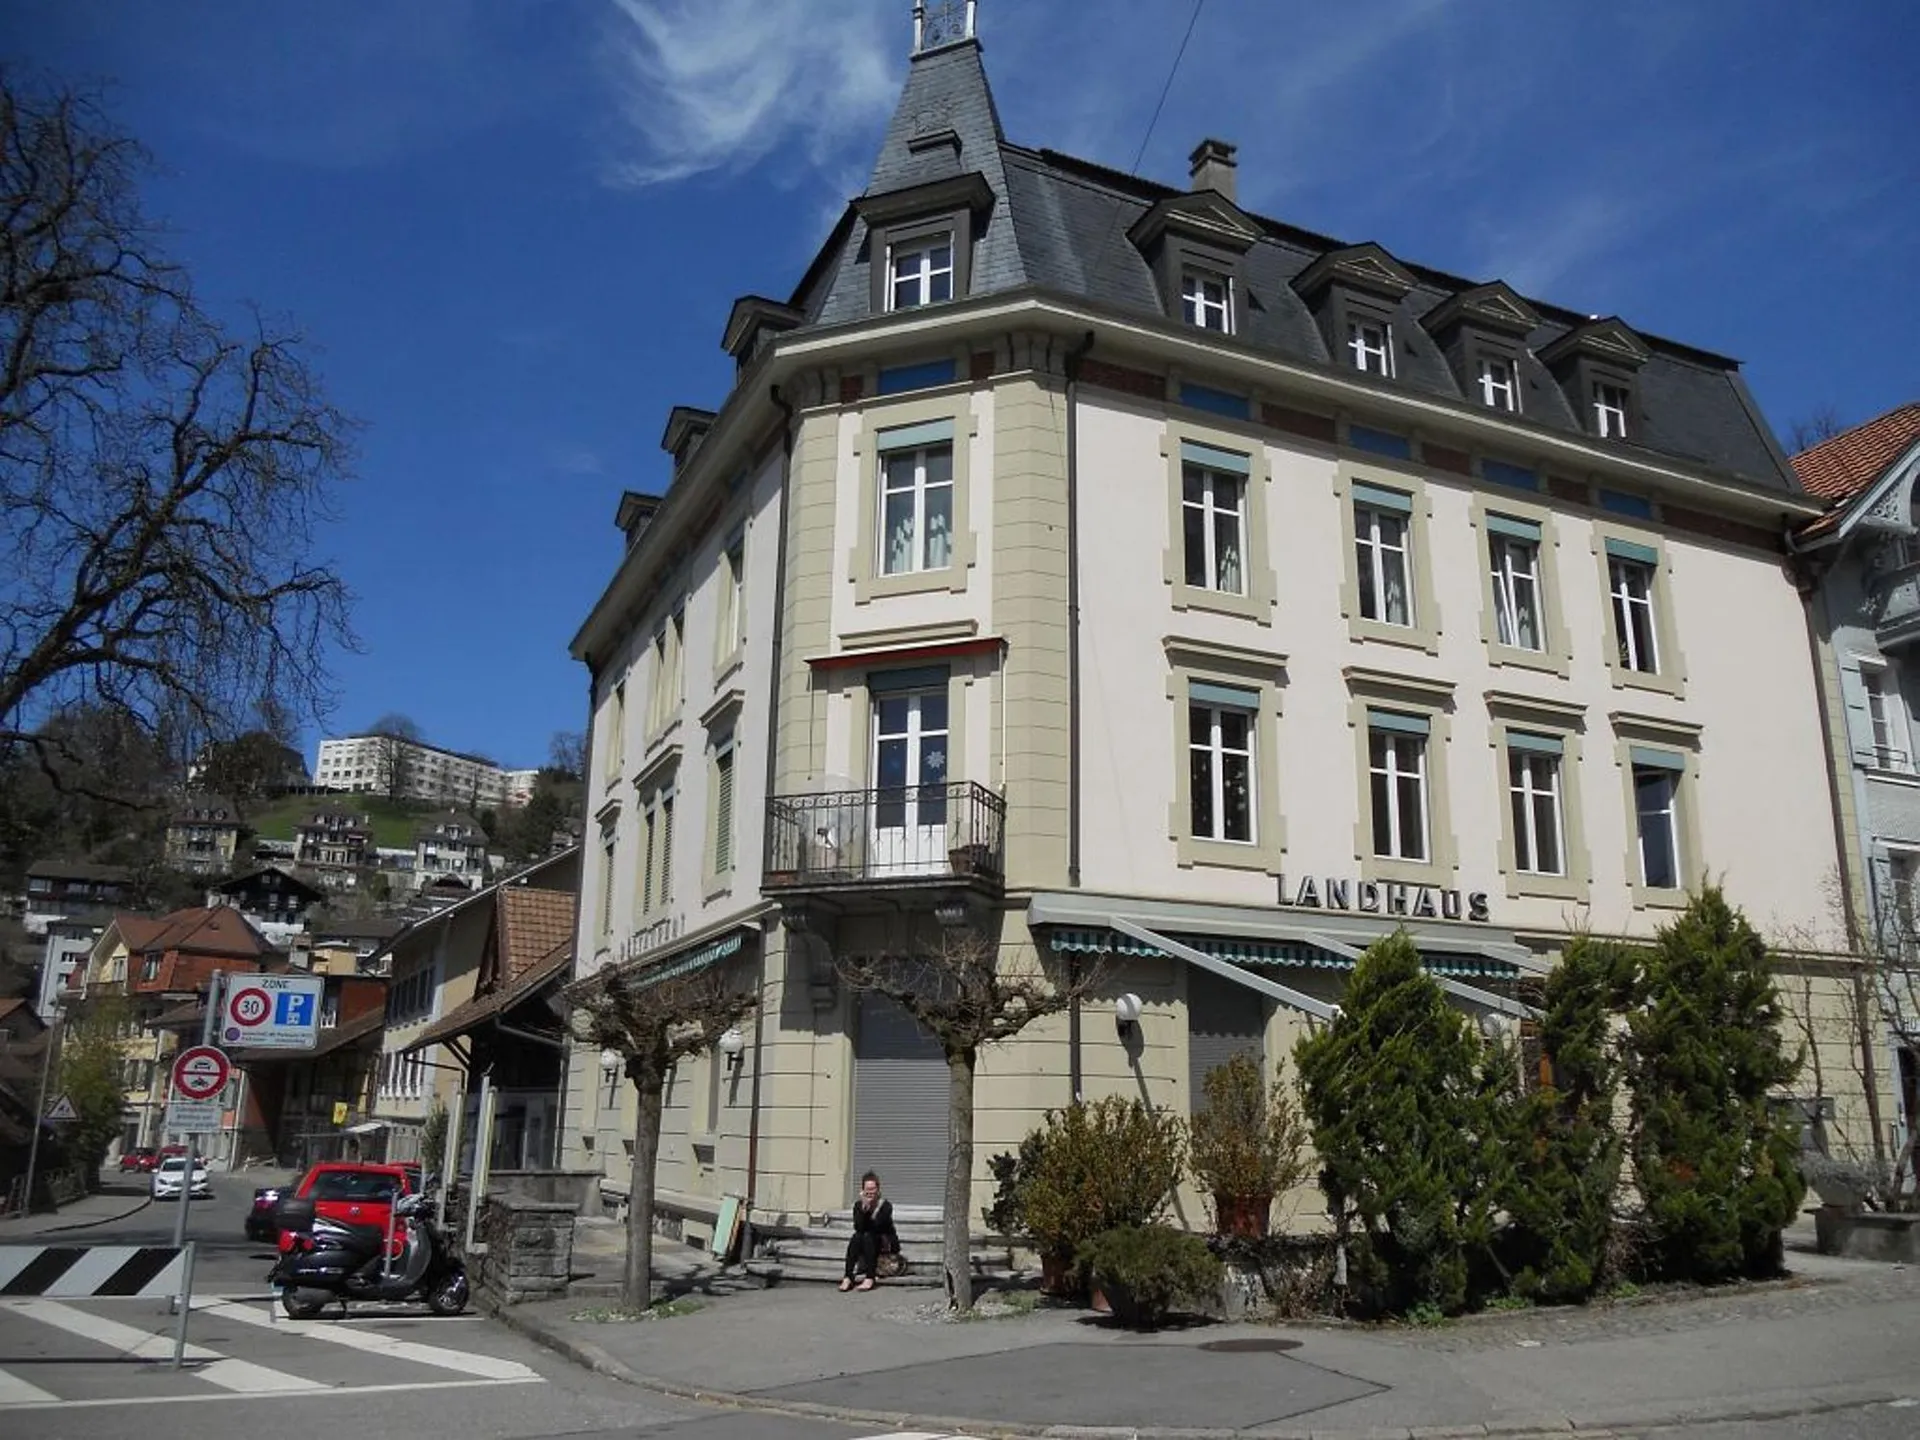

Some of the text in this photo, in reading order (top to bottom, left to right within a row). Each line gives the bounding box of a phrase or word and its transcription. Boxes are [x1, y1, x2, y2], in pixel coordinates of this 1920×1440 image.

[1277, 873, 1490, 923] LANDHAUS
[261, 978, 291, 989] ZONE
[241, 1000, 260, 1016] 30
[288, 995, 305, 1012] P
